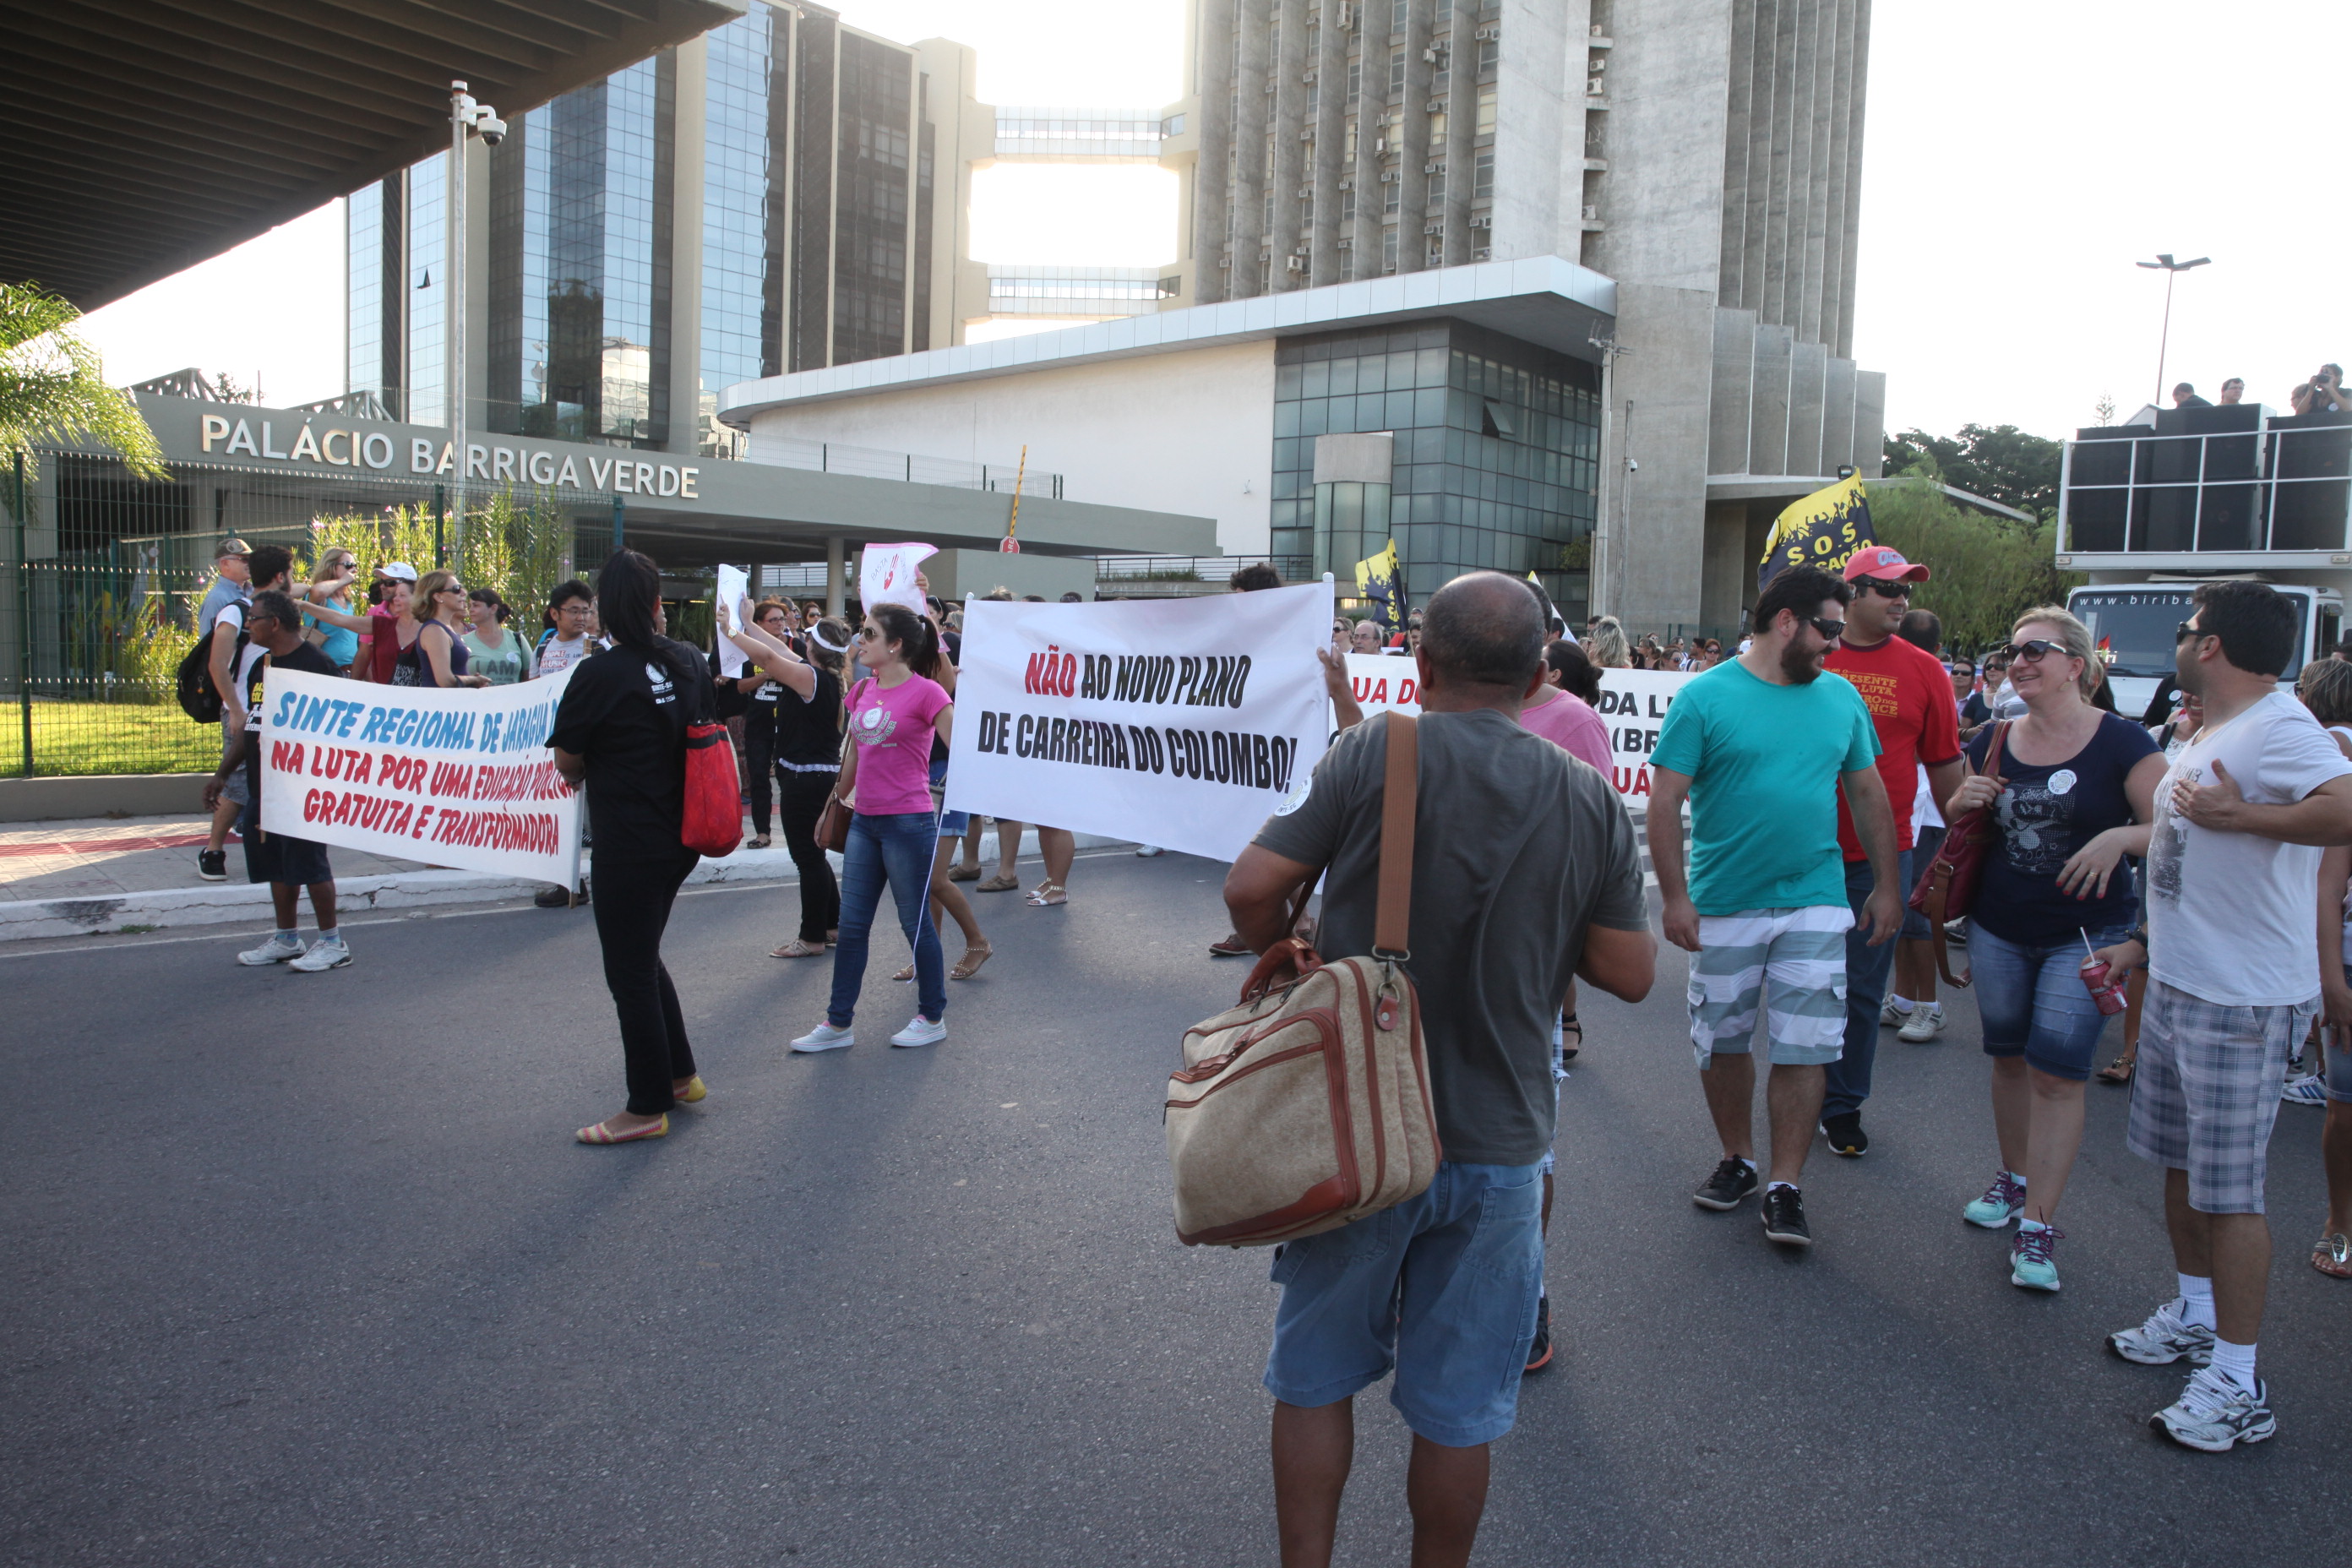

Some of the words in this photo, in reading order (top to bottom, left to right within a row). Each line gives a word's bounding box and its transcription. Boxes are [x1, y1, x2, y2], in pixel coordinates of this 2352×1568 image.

[202, 414, 395, 471] PALÁCIO
[411, 438, 581, 489] BARRIGA
[588, 456, 700, 499] VERDE
[2079, 595, 2194, 606] www.biriba
[486, 660, 515, 675] AM
[1025, 644, 1077, 699] NÃO
[1081, 653, 1113, 701] AO
[1113, 655, 1173, 705] NOVO
[1173, 654, 1252, 709] PLANO
[272, 690, 365, 738] SINTE
[360, 705, 476, 751] REGIONAL
[479, 711, 503, 754] DE
[501, 686, 553, 754] JARAGUÁ
[977, 710, 1010, 754] DE
[1015, 714, 1130, 770] CARREIRA
[1128, 724, 1165, 775] DO
[1165, 727, 1298, 794] COLOMBO!
[270, 741, 305, 776] NA
[310, 746, 373, 786] LUTA
[377, 754, 428, 796] POR
[430, 760, 474, 800] UMA
[472, 754, 534, 812] EDUCAÇÃO
[303, 788, 414, 836] GRATUITA
[411, 804, 435, 840] E
[430, 808, 559, 858] TRANSFORMADORA
